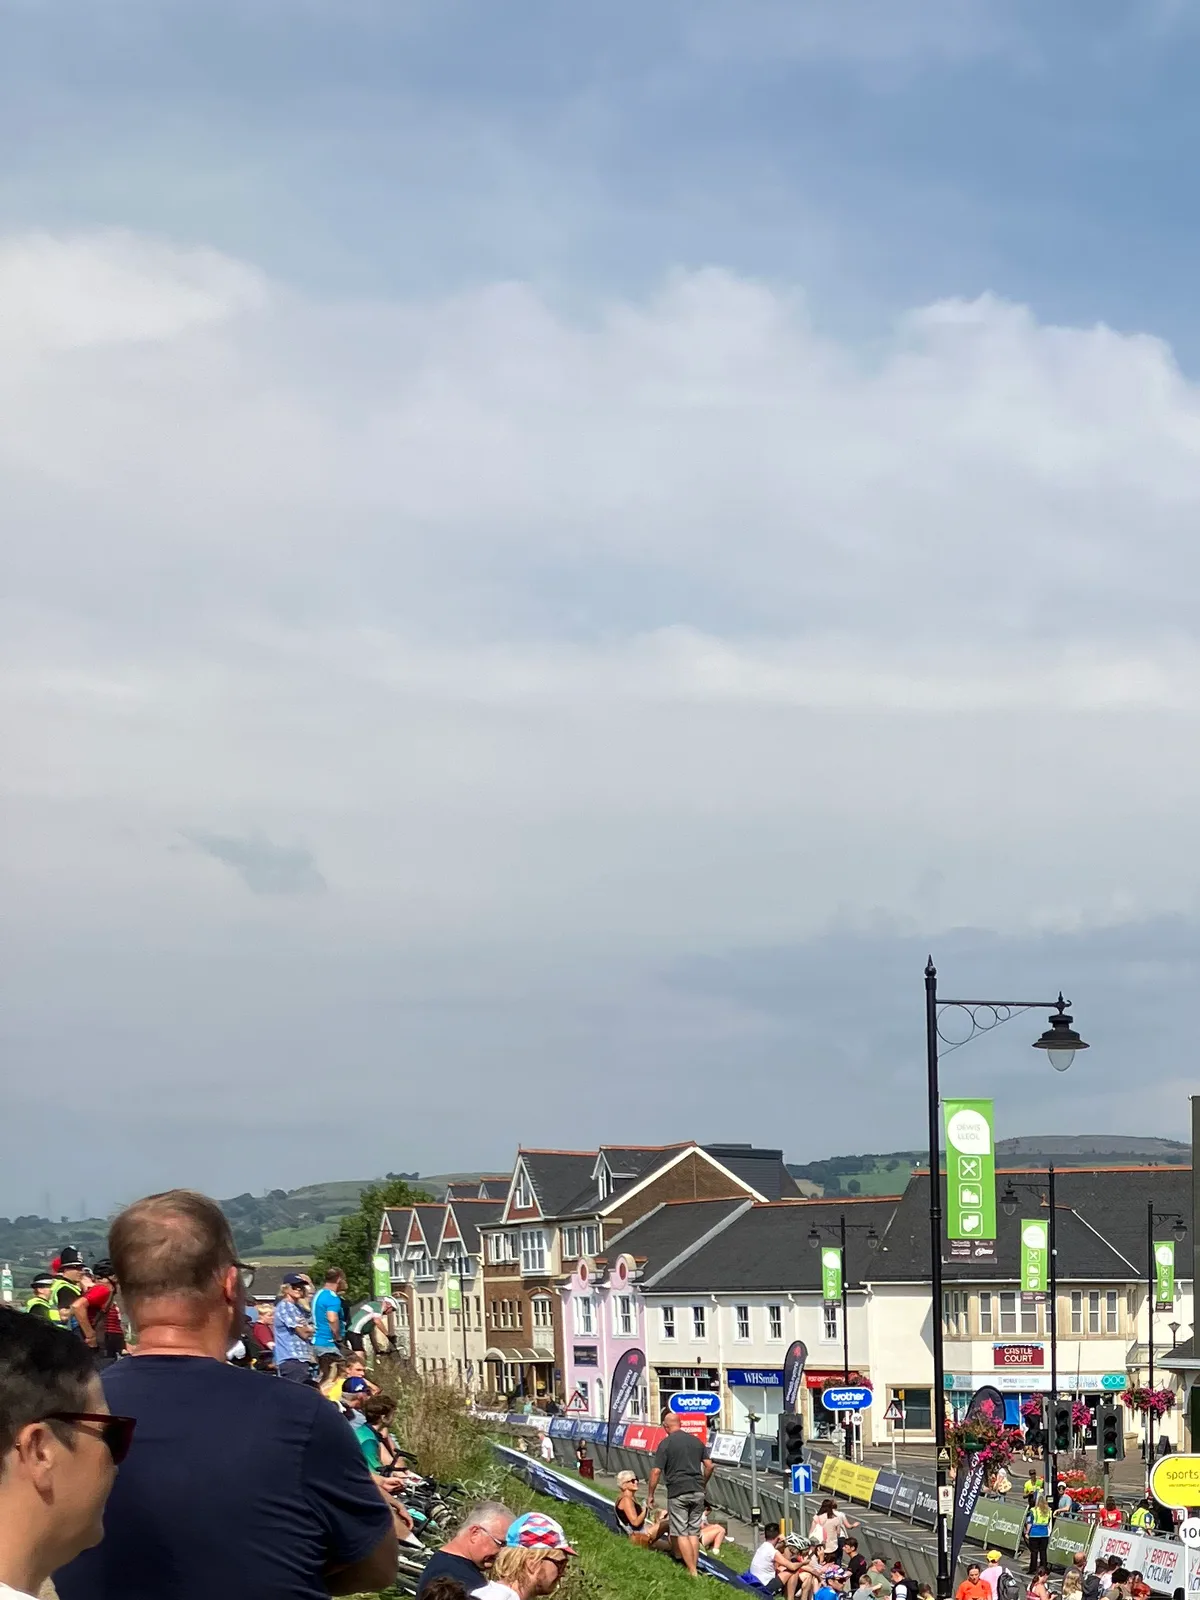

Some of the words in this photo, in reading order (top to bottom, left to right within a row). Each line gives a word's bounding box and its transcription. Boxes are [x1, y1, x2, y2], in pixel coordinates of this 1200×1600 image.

[956, 1123, 981, 1132] DEWIS
[957, 1132, 981, 1141] LLEOL
[1004, 1347, 1033, 1355] CASTLE
[1004, 1354, 1033, 1363] COURT
[743, 1372, 780, 1385] WHSmith
[678, 1397, 714, 1407] brother
[831, 1392, 865, 1402] brother
[1105, 1538, 1133, 1557] BRITISH
[1150, 1548, 1179, 1569] BRITISH
[1146, 1567, 1174, 1585] CYCLING
